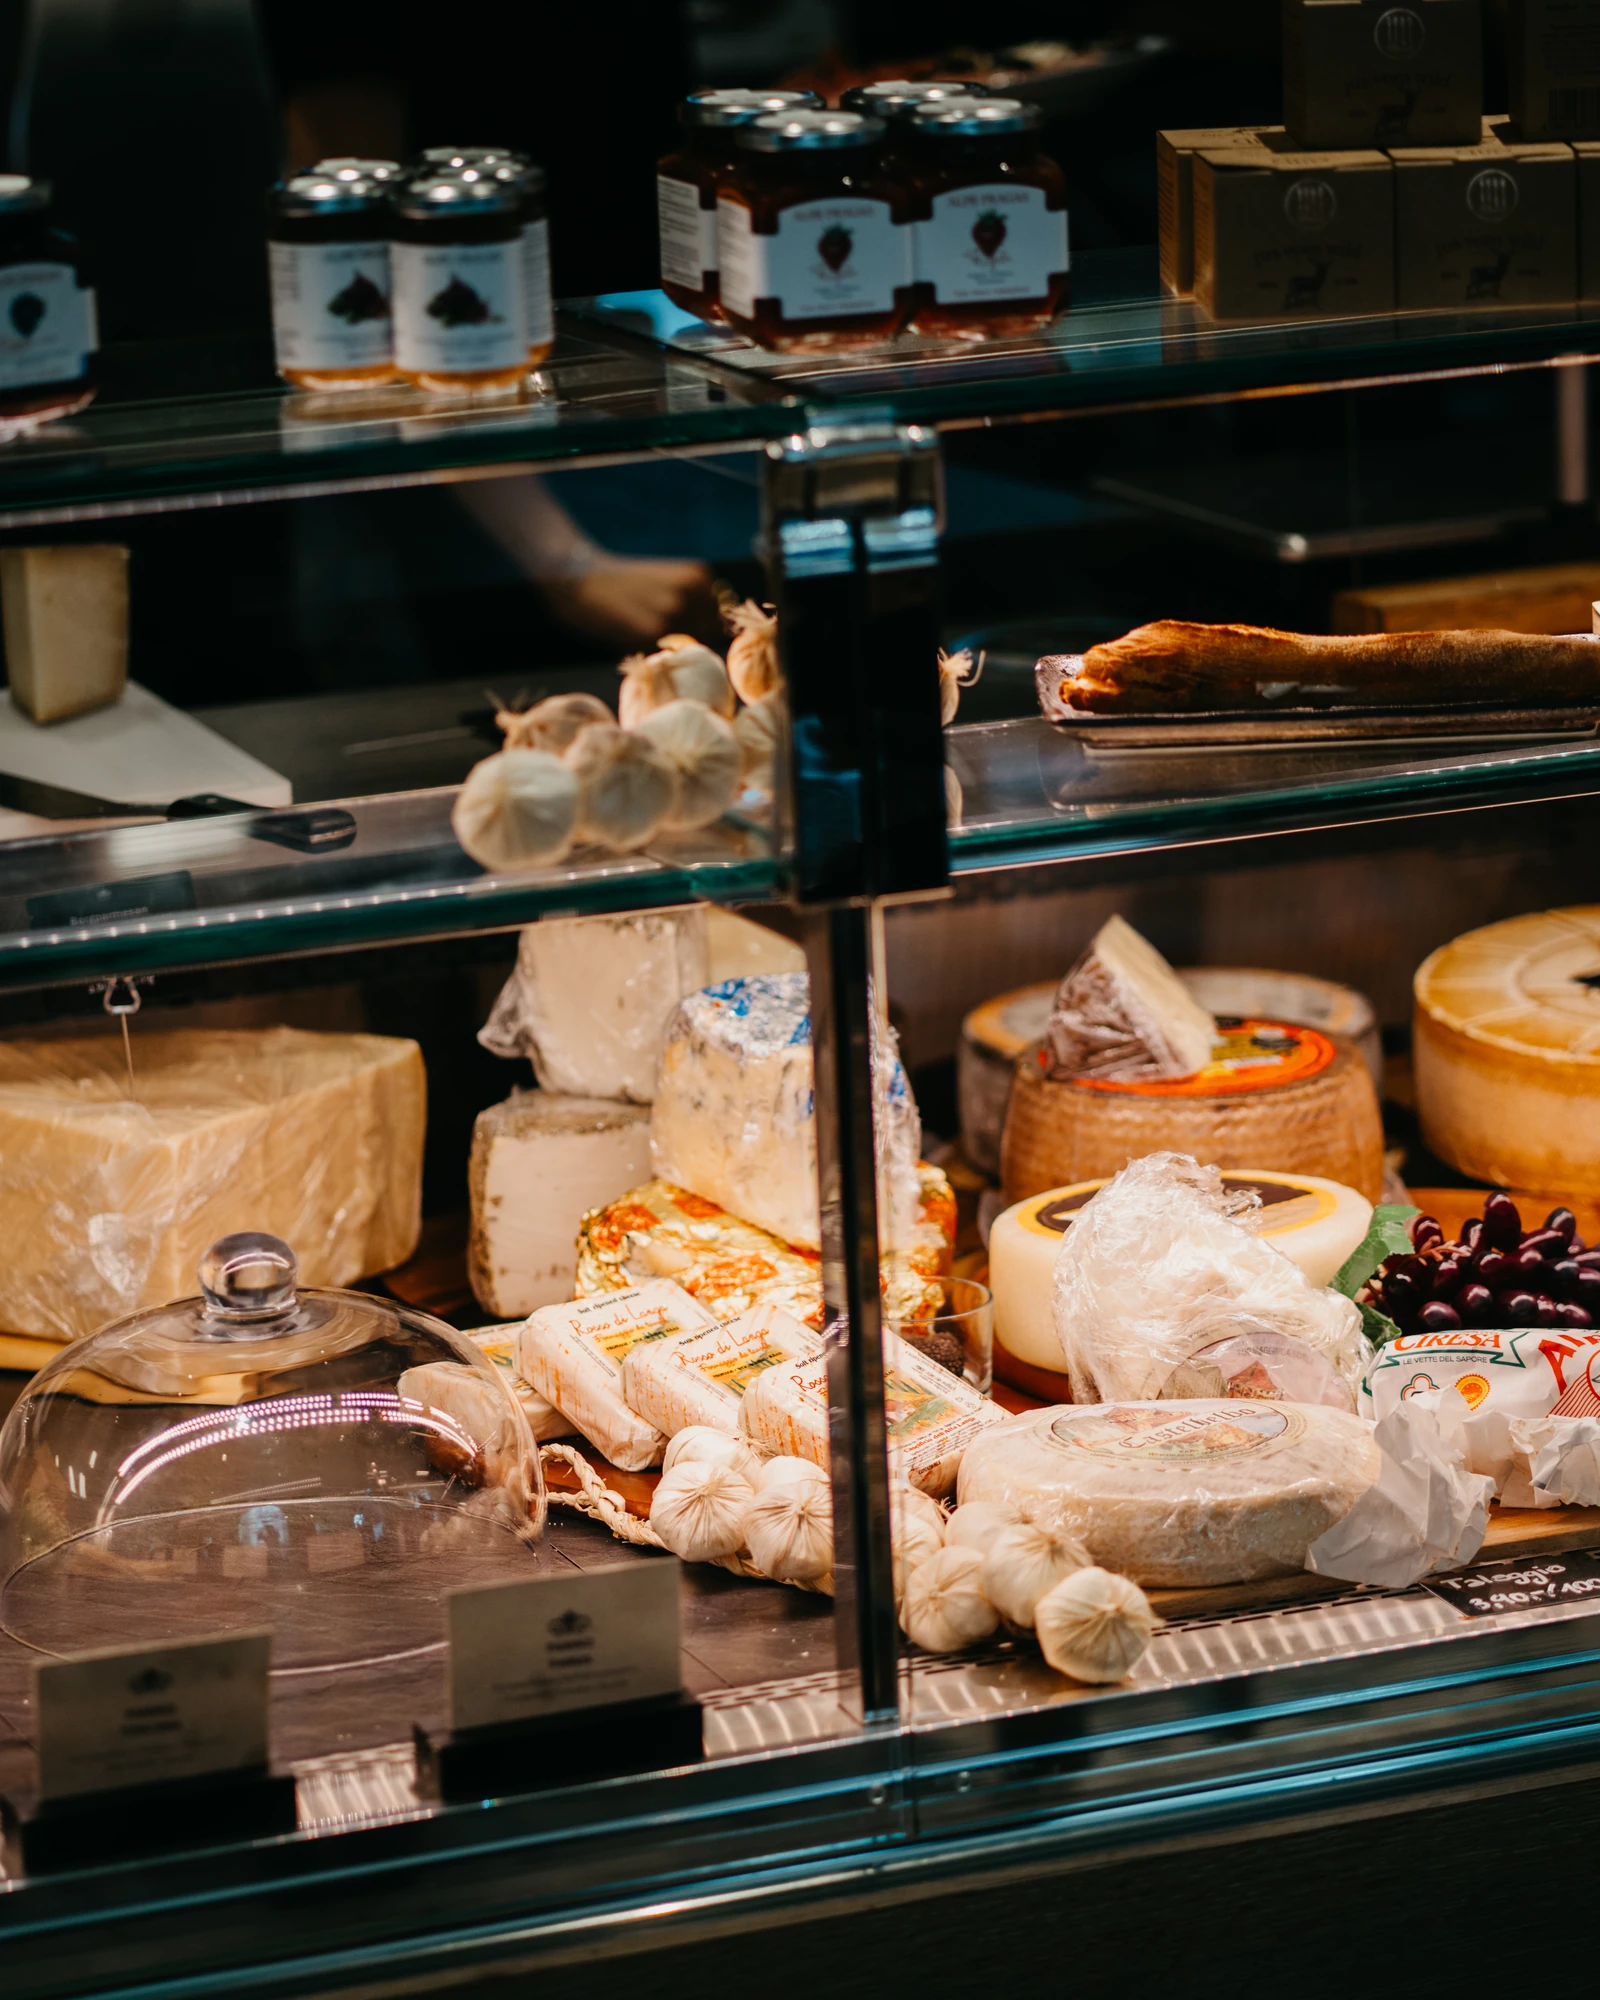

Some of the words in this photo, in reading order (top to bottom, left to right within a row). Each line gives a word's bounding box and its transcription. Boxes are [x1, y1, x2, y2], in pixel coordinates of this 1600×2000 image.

[614, 1311, 628, 1326] di
[716, 1340, 732, 1355] di
[726, 1328, 770, 1348] Langa
[1394, 1333, 1501, 1351] CIRESA
[1413, 1356, 1438, 1364] VETTE
[1439, 1355, 1453, 1363] DEL
[1456, 1355, 1488, 1364] SAPORE
[1439, 1564, 1566, 1590] Taleggio
